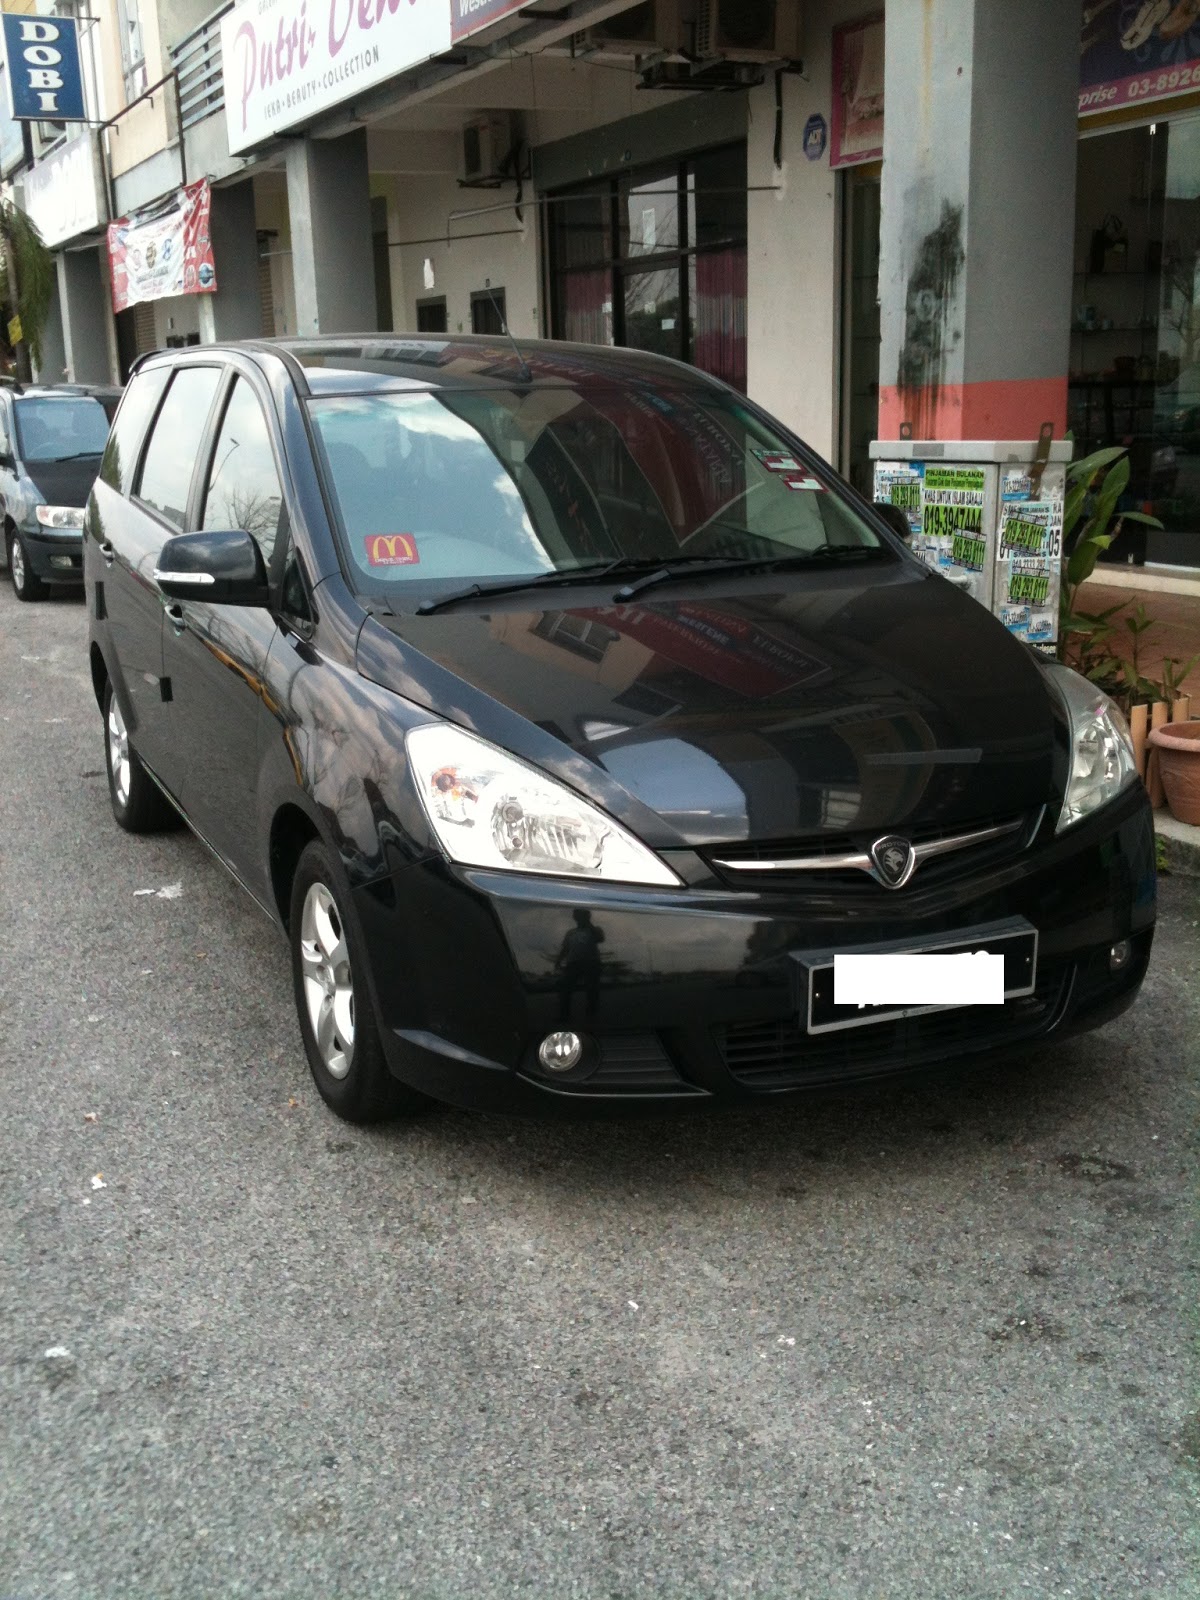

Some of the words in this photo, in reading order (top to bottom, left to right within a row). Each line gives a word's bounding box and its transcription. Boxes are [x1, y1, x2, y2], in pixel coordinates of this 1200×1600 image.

[19, 21, 64, 112] DOBI
[286, 80, 316, 108] BEAUTY
[323, 45, 379, 89] COLLECTION
[926, 469, 955, 478] PINJAMAN
